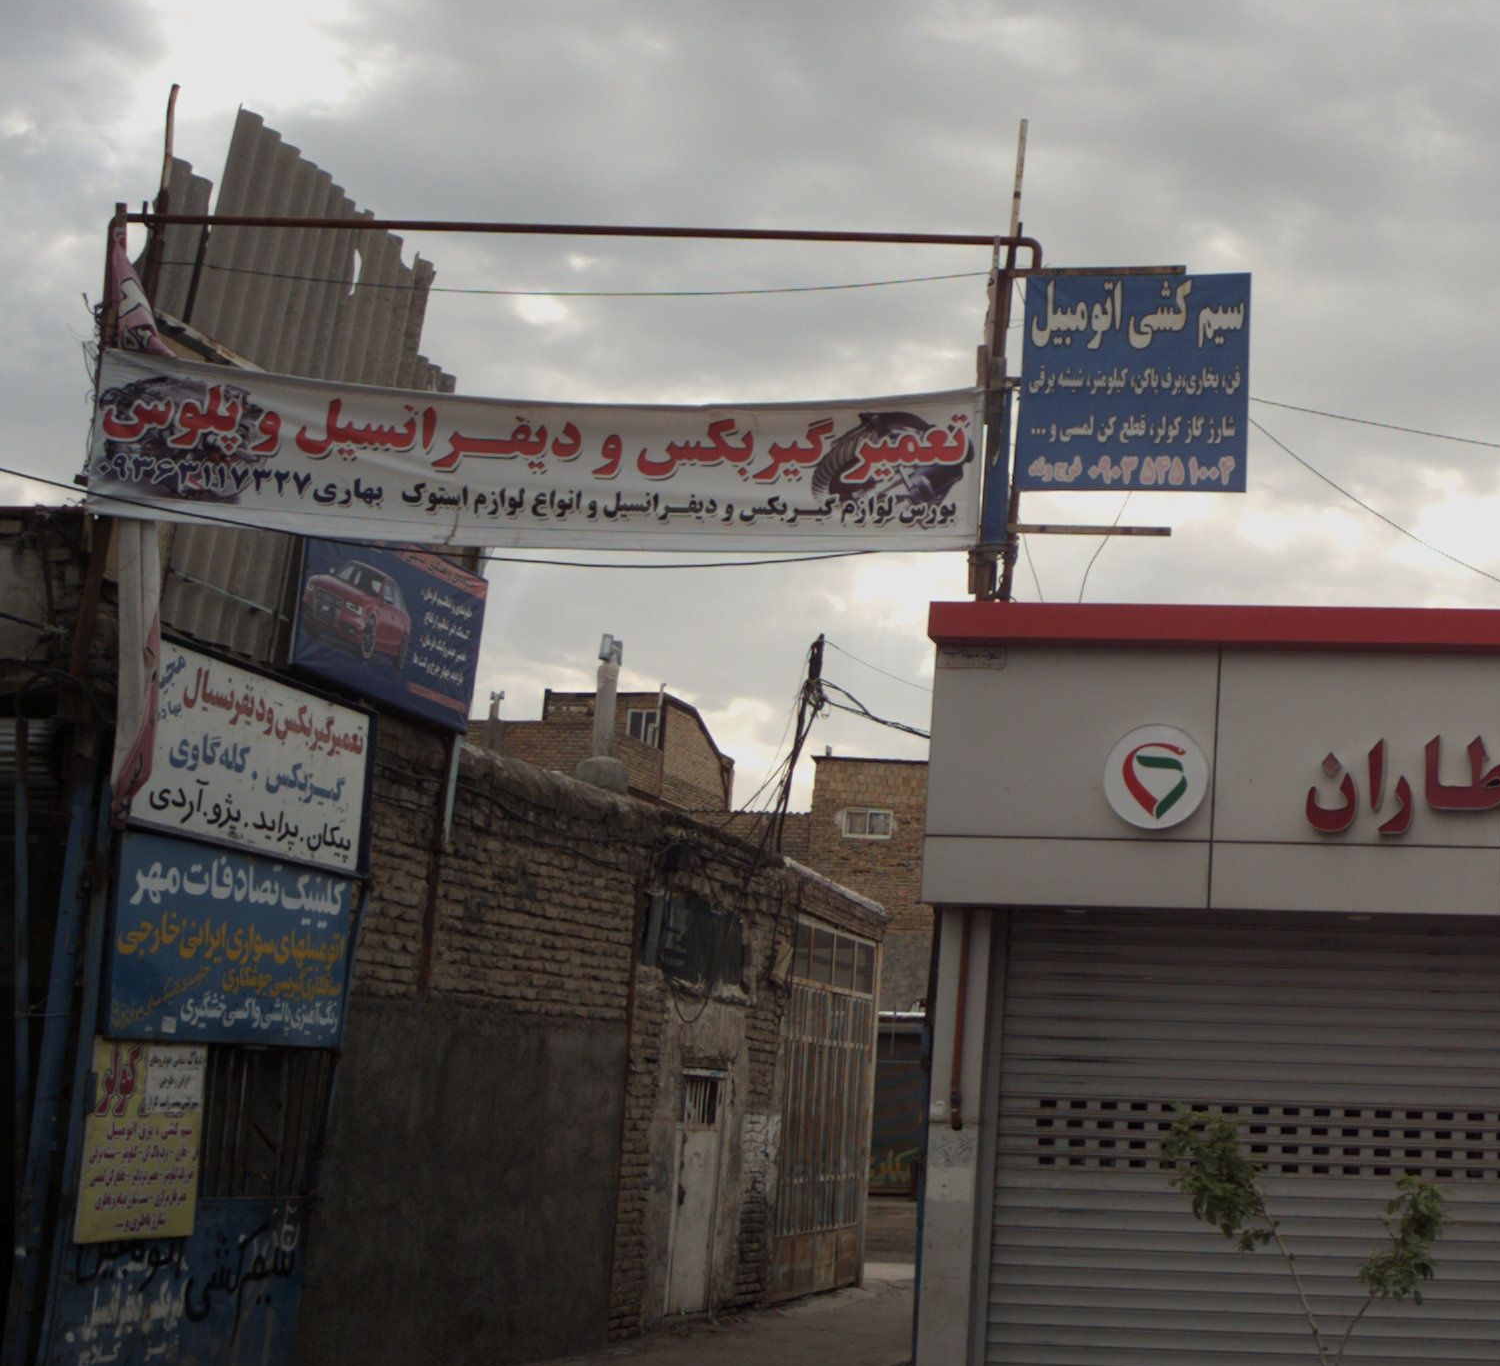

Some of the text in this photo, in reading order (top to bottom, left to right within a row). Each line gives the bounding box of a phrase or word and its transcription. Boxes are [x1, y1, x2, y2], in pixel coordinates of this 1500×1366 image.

[1032, 279, 1245, 349] سیم کشی اتومبیل
[1029, 365, 1056, 394] برقی
[1057, 369, 1084, 393] شیشه
[102, 385, 969, 482] تعمیر گیربکس و دیفرانسیل و پلوس
[1059, 414, 1094, 443] لمسی
[1097, 415, 1117, 443] کن
[1119, 414, 1146, 443] قطع
[1184, 416, 1205, 444] گاز
[1207, 416, 1236, 444] شارژ
[313, 477, 383, 505] بهاری
[402, 482, 467, 512] استوک
[474, 487, 525, 516] لوازم
[532, 490, 581, 518] انواع
[588, 498, 597, 518] و
[603, 492, 717, 523] دیفرانسیل
[723, 504, 733, 522] و
[739, 497, 835, 524] گیربکس
[842, 496, 892, 523] لوازم
[899, 498, 956, 526] بورس
[275, 704, 336, 750] گیربکس
[327, 726, 363, 756] تعمیر
[169, 733, 221, 771] گاوی
[219, 742, 250, 773] کله
[150, 778, 209, 823] آردی
[129, 855, 346, 929] کلینیک تصادفات مهر
[117, 911, 180, 956] خارجی
[226, 923, 275, 964] سواری
